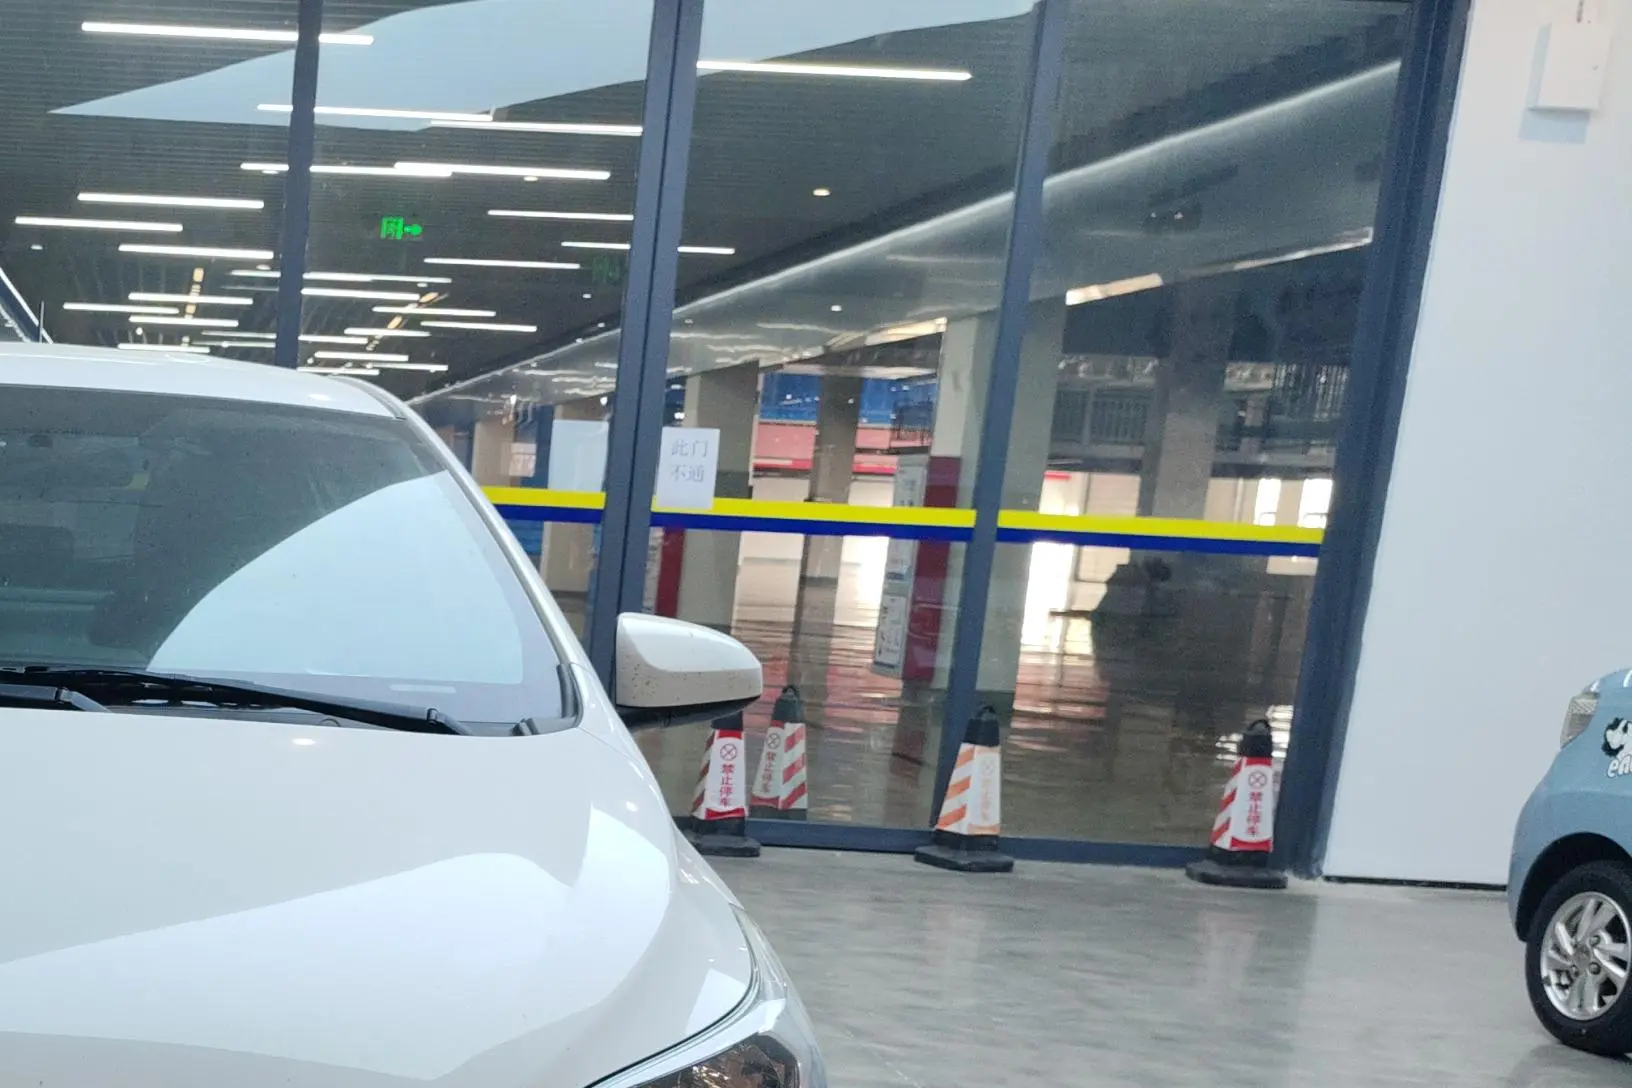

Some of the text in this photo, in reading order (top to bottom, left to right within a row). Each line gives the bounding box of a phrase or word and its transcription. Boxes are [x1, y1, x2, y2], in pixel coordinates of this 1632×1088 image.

[671, 439, 708, 458] 此门
[670, 464, 705, 483] 不通
[720, 763, 735, 807] 禁止停车
[1247, 791, 1263, 836] 禁止停车
